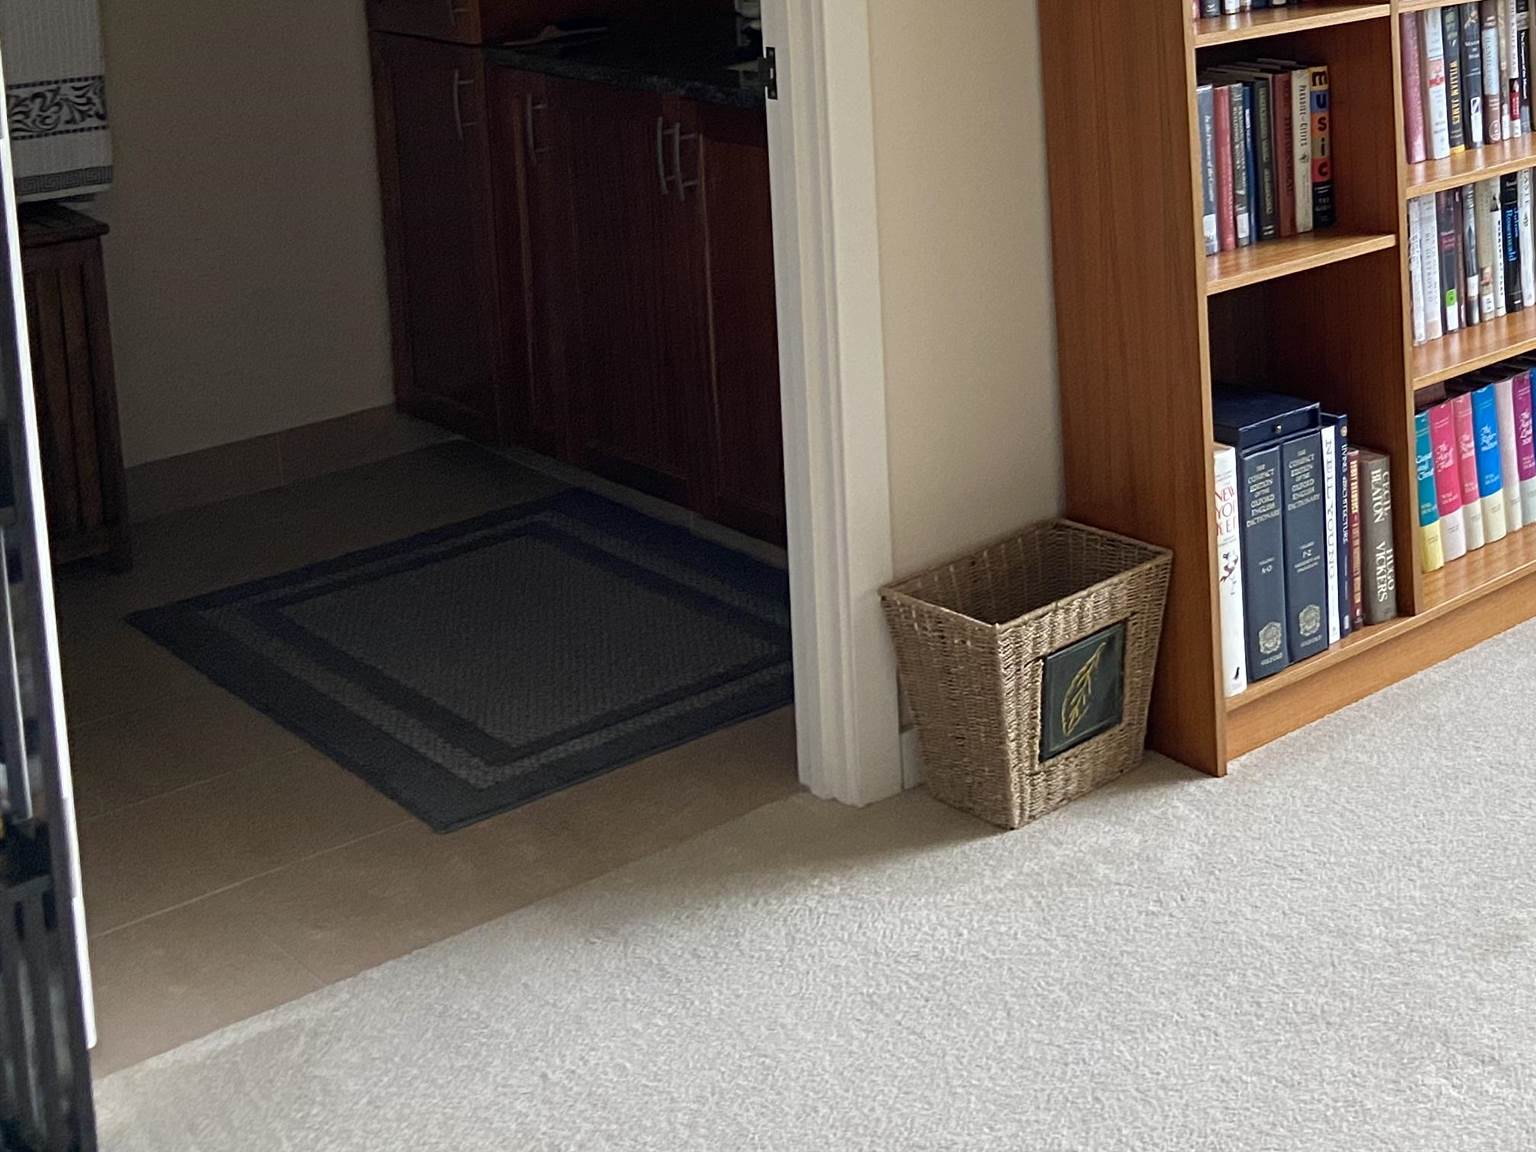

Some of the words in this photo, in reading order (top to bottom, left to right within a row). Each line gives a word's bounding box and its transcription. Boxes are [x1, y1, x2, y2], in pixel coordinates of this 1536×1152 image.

[1449, 61, 1460, 96] WILLIAM
[1451, 99, 1461, 124] JAMES
[1506, 209, 1517, 262] Rosenwald
[1325, 439, 1334, 499] NEIL
[1287, 494, 1321, 512] DICTIONARY
[1370, 469, 1384, 524] BEATON
[1382, 471, 1391, 514] CECIL
[1246, 509, 1281, 528] DICTIONARY
[1326, 503, 1336, 579] YOUNG
[1375, 541, 1388, 603] VICKERS
[1386, 547, 1396, 591] HUGO
